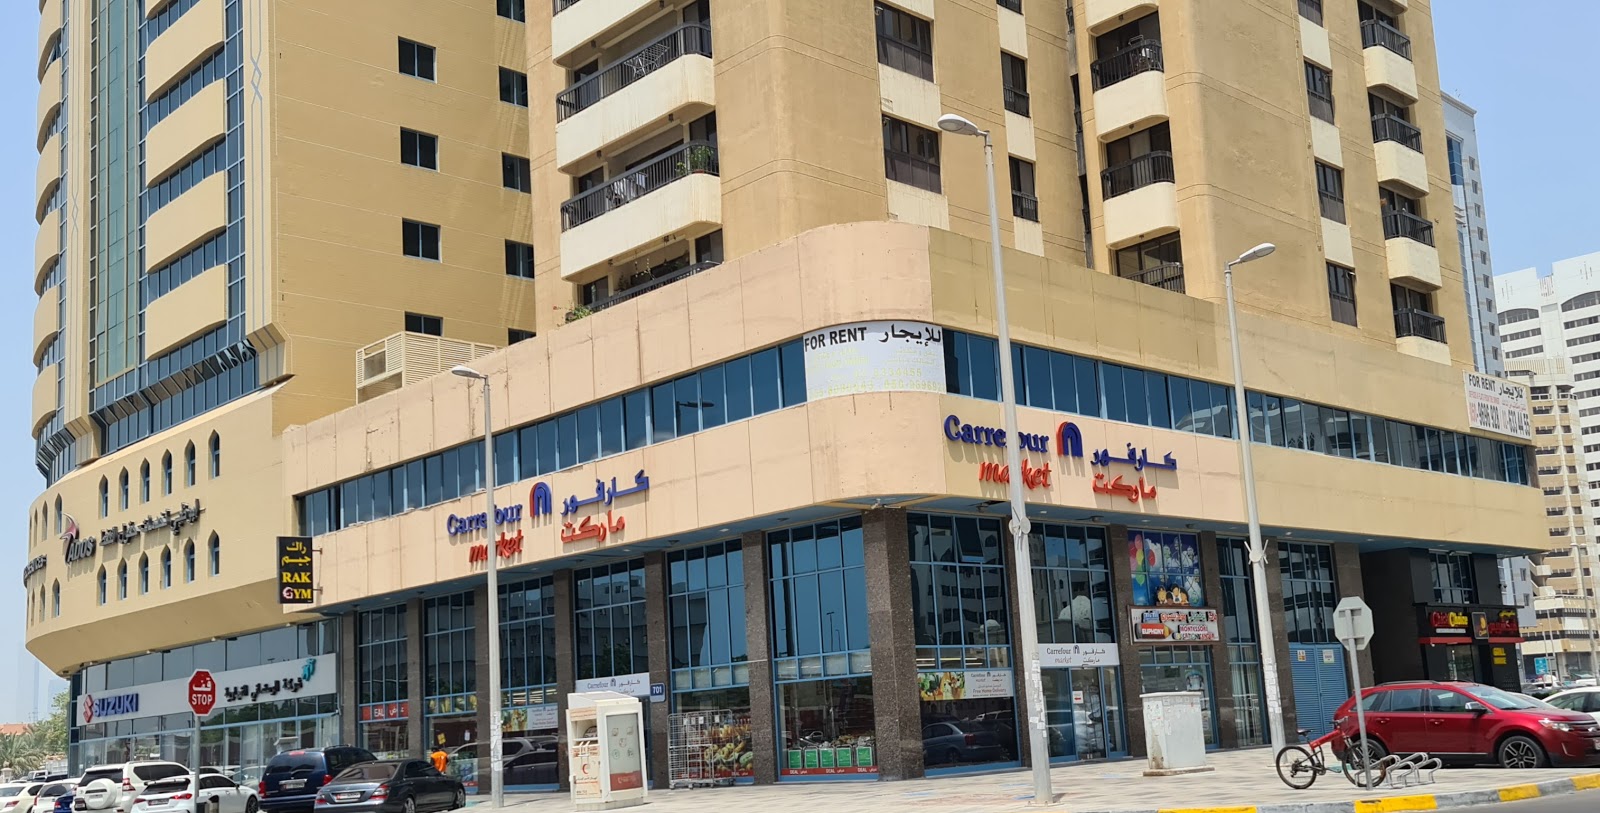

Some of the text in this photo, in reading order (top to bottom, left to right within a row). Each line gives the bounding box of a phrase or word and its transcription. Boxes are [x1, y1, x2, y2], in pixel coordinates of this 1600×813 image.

[804, 326, 867, 352] FOR RENT
[878, 323, 941, 347] للإيجار
[1469, 374, 1495, 392] FOR RENT
[1498, 383, 1523, 401] للإيجار
[944, 414, 1049, 453] Carreour
[1090, 442, 1177, 471] كارفور
[979, 458, 1052, 490] maket
[560, 469, 649, 516] كارفور
[1092, 473, 1157, 503] ماركت
[447, 504, 523, 536] Carreour
[561, 510, 625, 543] ماركت
[66, 536, 96, 564] ADOS
[286, 541, 307, 554] راك
[281, 555, 311, 567] جيم
[282, 572, 312, 583] RAK
[282, 586, 312, 599] GYM
[1083, 648, 1105, 656] كارفور
[192, 677, 211, 691] قف
[652, 686, 662, 694] 701
[93, 693, 139, 717] SUZUKI
[191, 694, 212, 705] STOP
